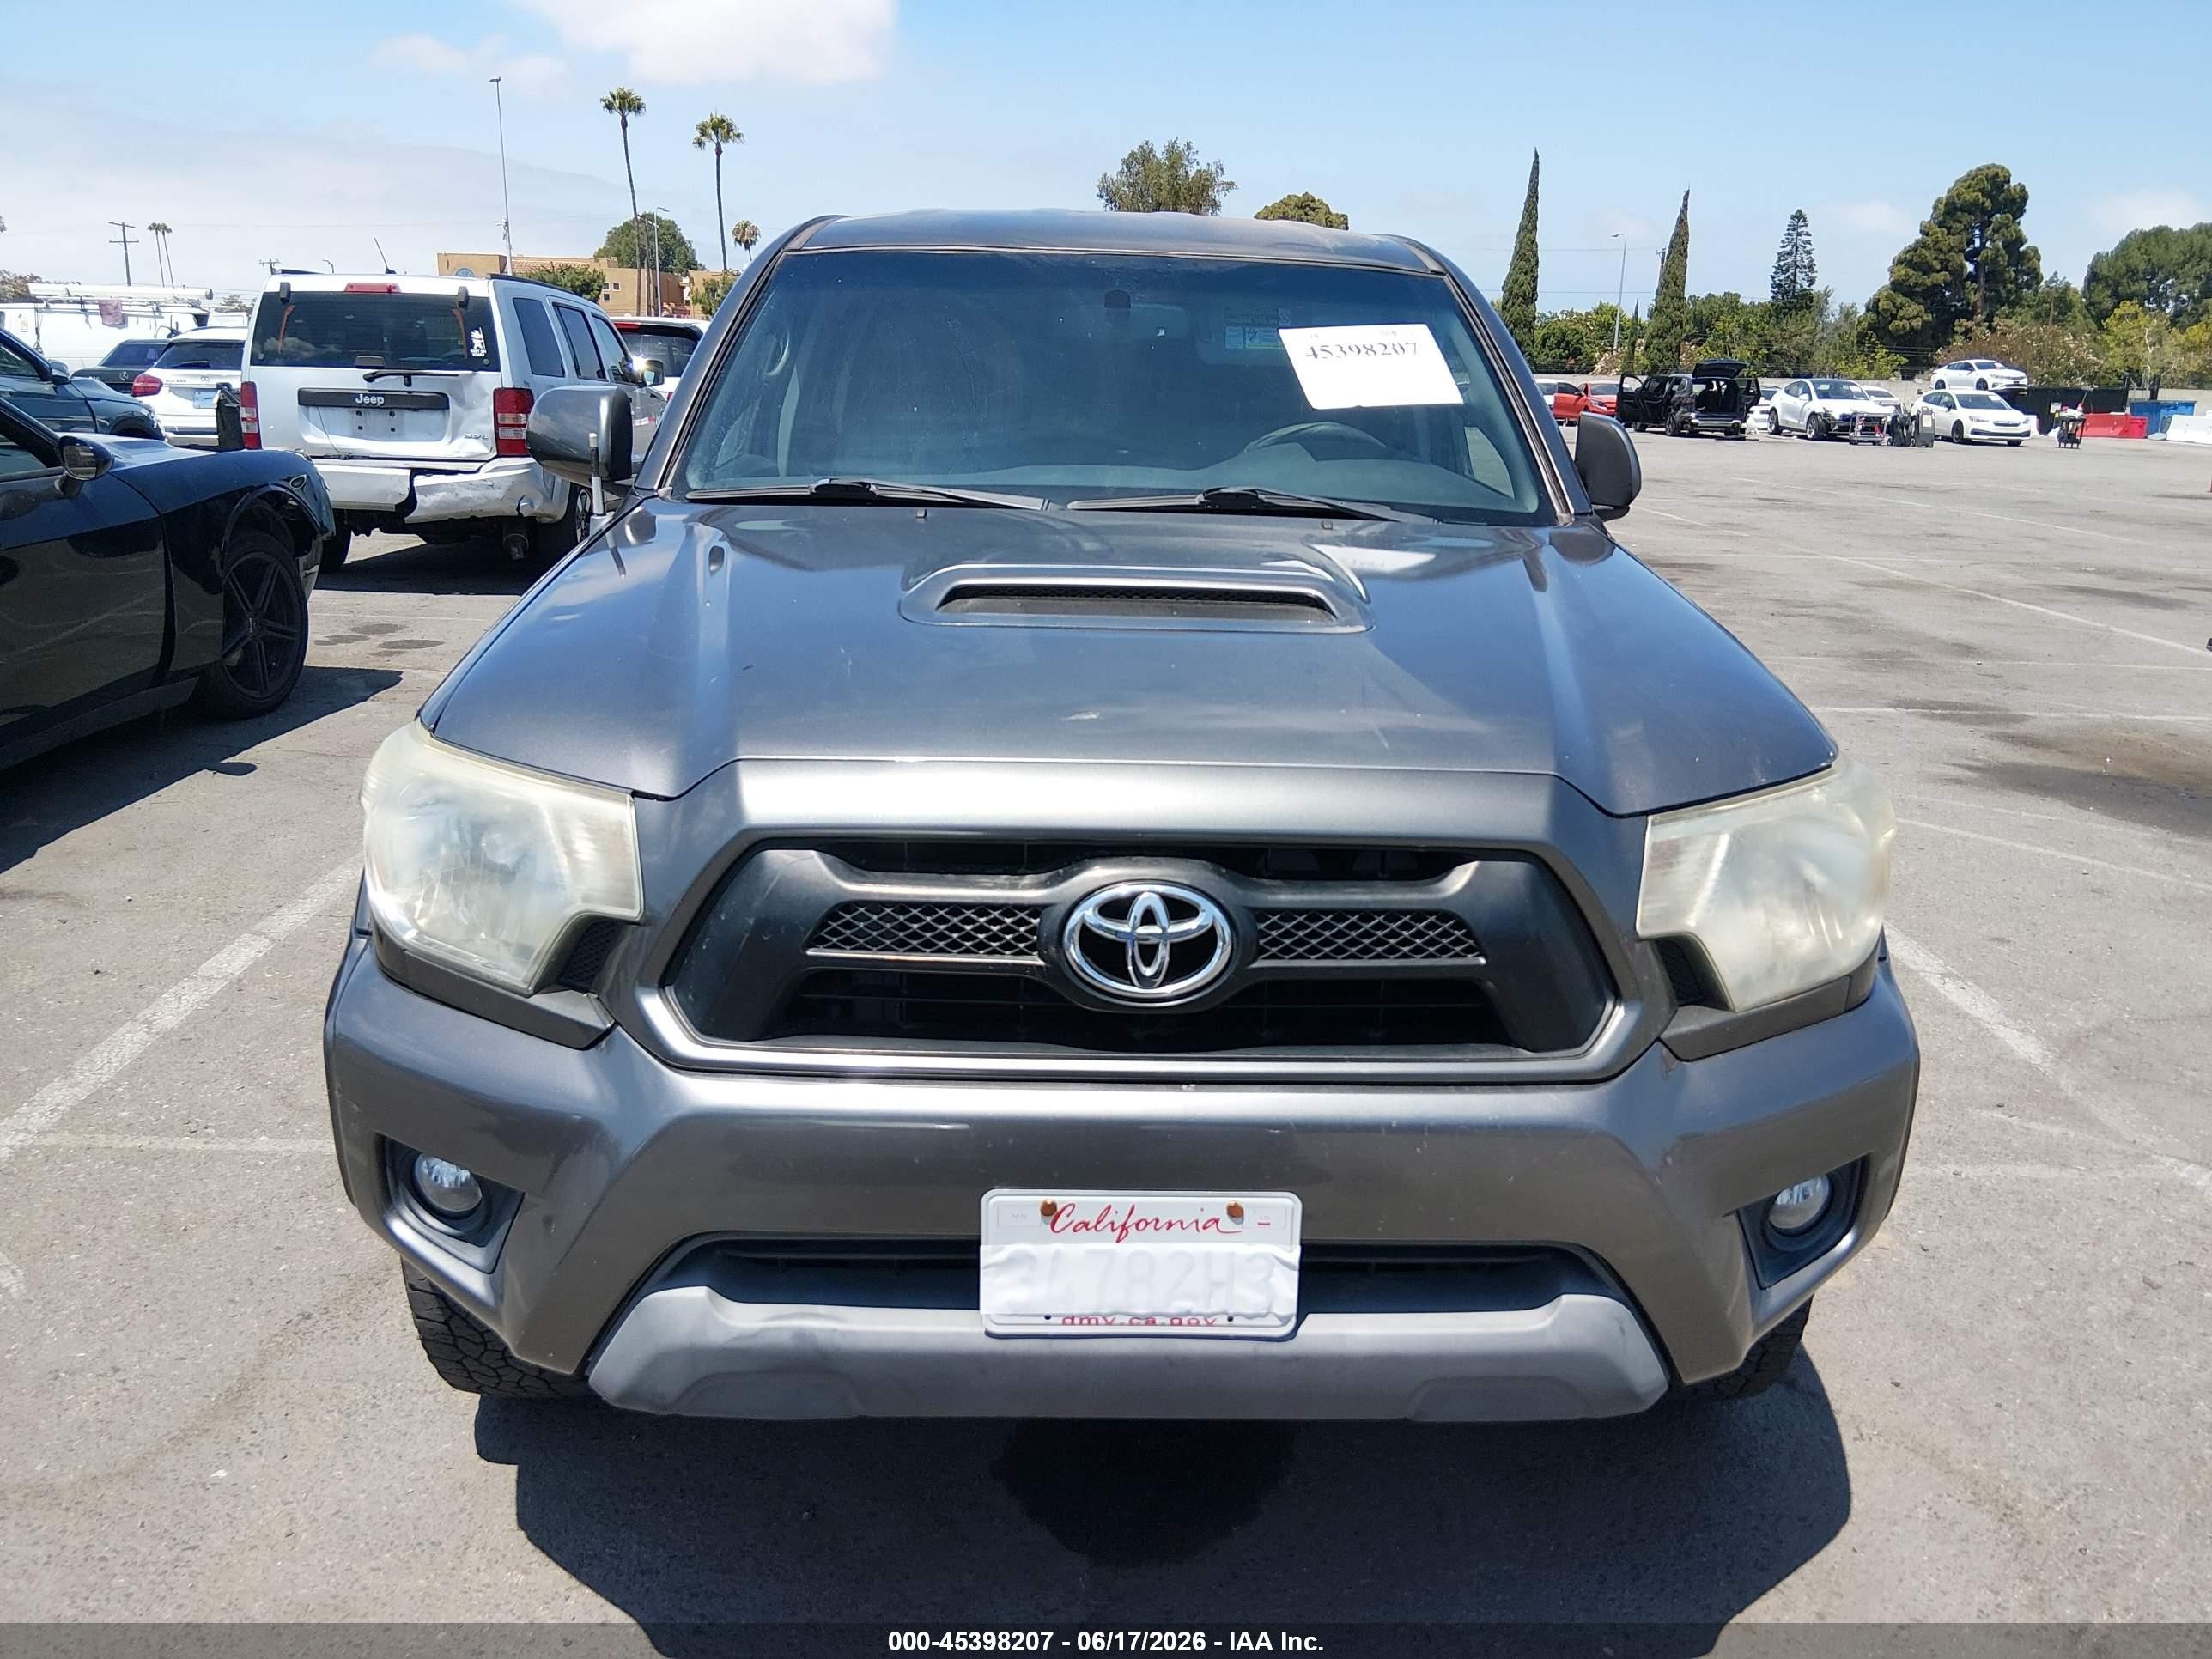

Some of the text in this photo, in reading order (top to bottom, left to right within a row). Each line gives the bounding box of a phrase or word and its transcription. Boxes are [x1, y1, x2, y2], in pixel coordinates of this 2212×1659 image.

[1305, 342, 1418, 359] 45398207
[355, 393, 385, 406] Jeep
[1050, 1203, 1242, 1243] California
[1061, 1315, 1218, 1326] dmv.ca.gov
